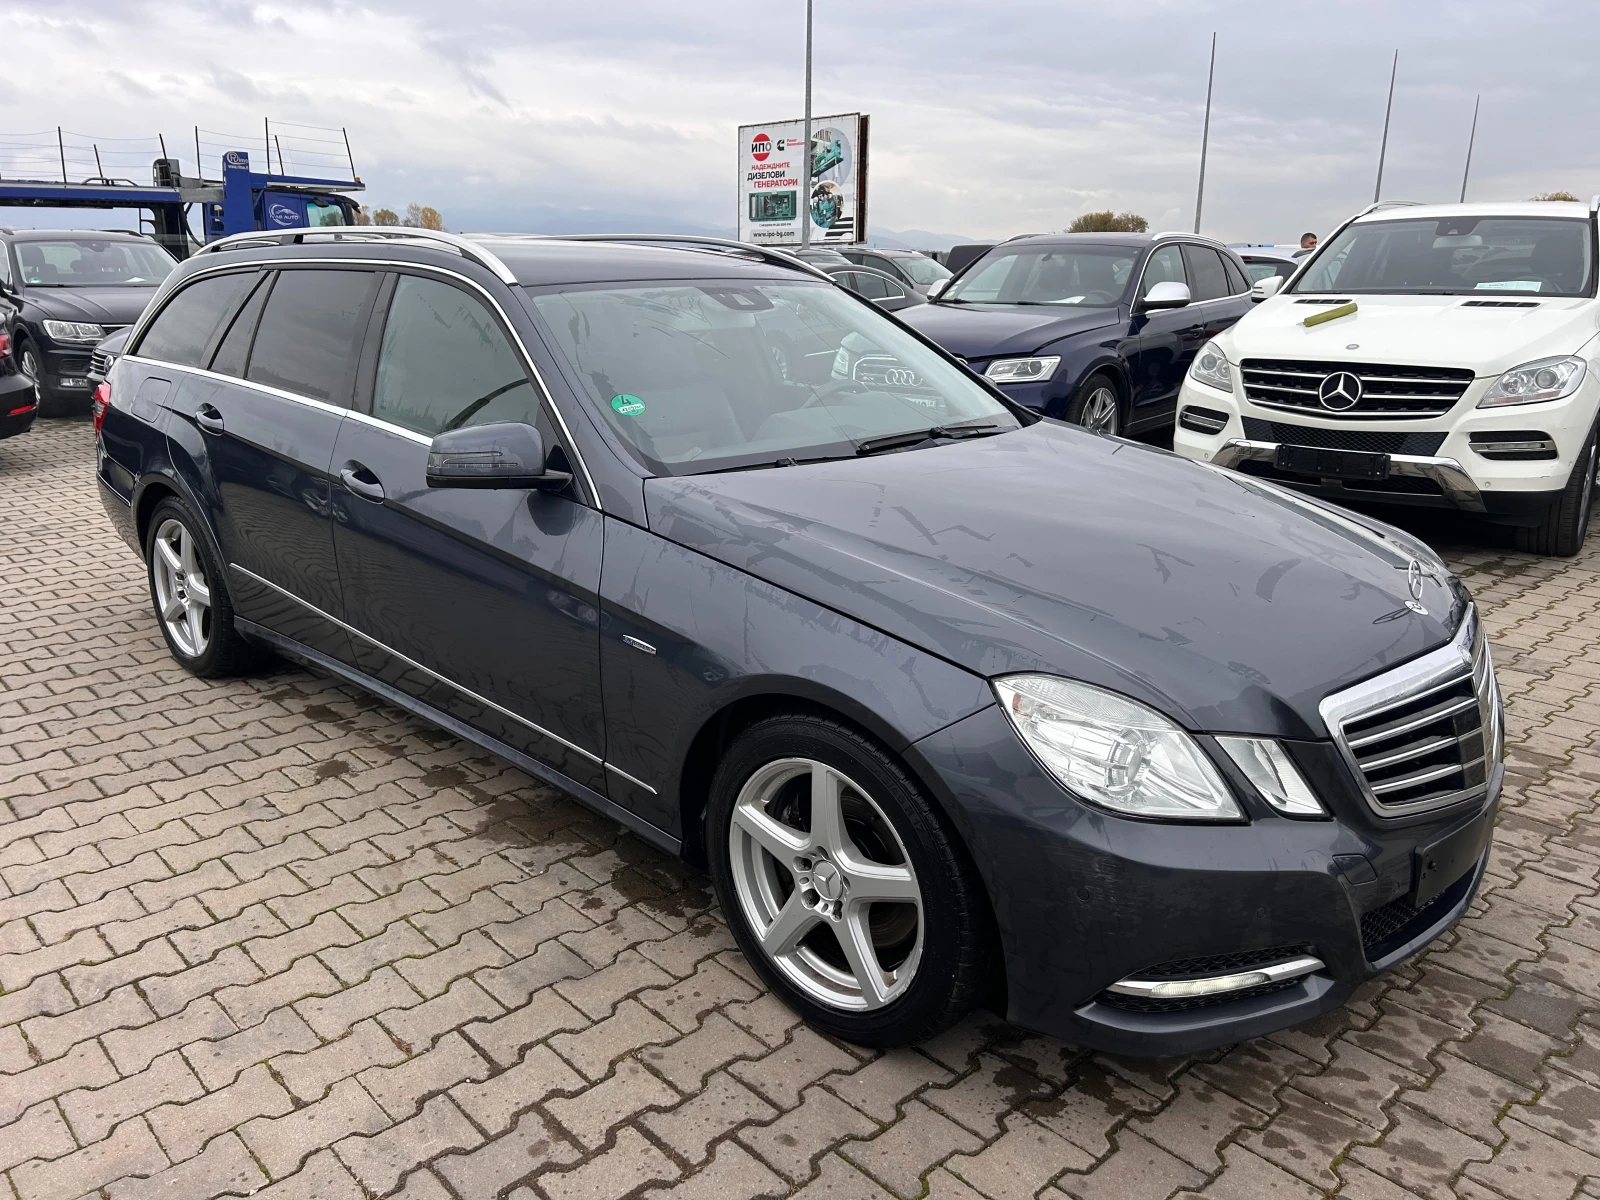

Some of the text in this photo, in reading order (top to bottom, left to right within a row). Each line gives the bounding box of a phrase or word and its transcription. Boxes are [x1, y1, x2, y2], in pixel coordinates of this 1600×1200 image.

[751, 142, 772, 153] ИПО
[752, 162, 790, 170] НАДЕЖДНИТЕ
[747, 170, 786, 181] ДИЗЕЛОВИ
[754, 178, 798, 188] ГЕНЕРАТОРИ
[753, 230, 794, 238] www.ipo-bg.com
[621, 395, 631, 405] 4
